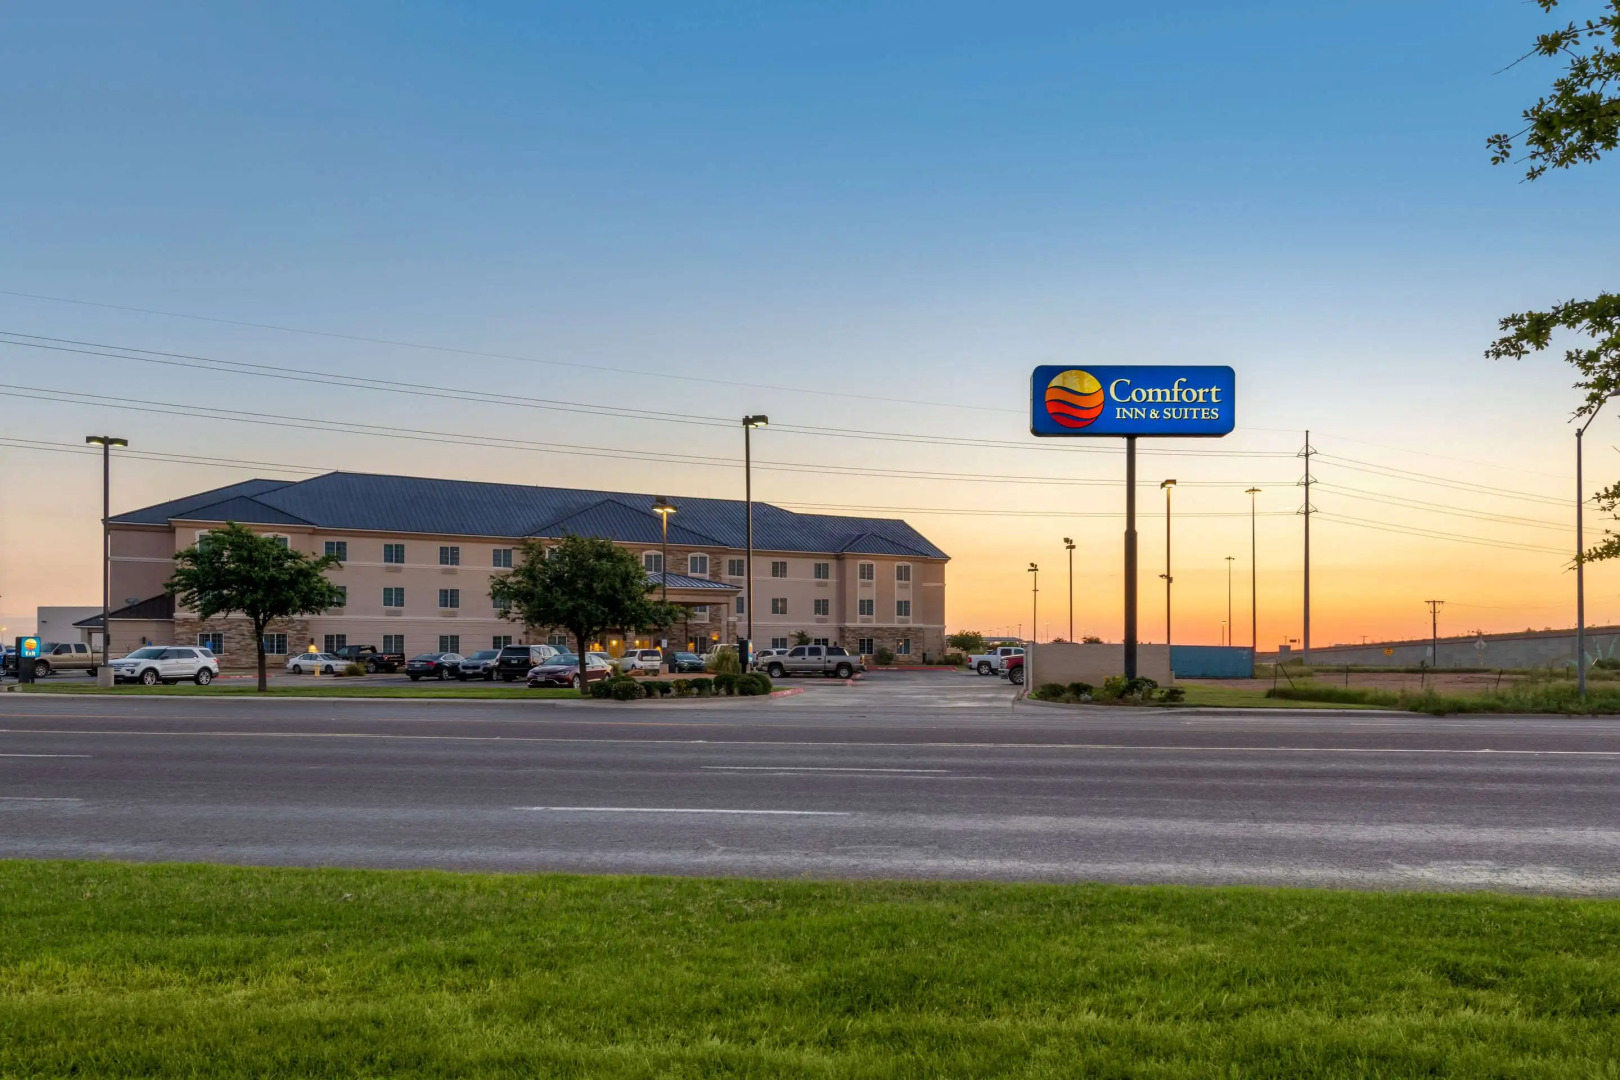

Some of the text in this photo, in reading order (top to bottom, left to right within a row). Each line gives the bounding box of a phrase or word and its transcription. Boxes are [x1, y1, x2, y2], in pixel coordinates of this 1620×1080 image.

[1109, 377, 1221, 403] Comfort
[1115, 407, 1219, 419] INN & SUITES
